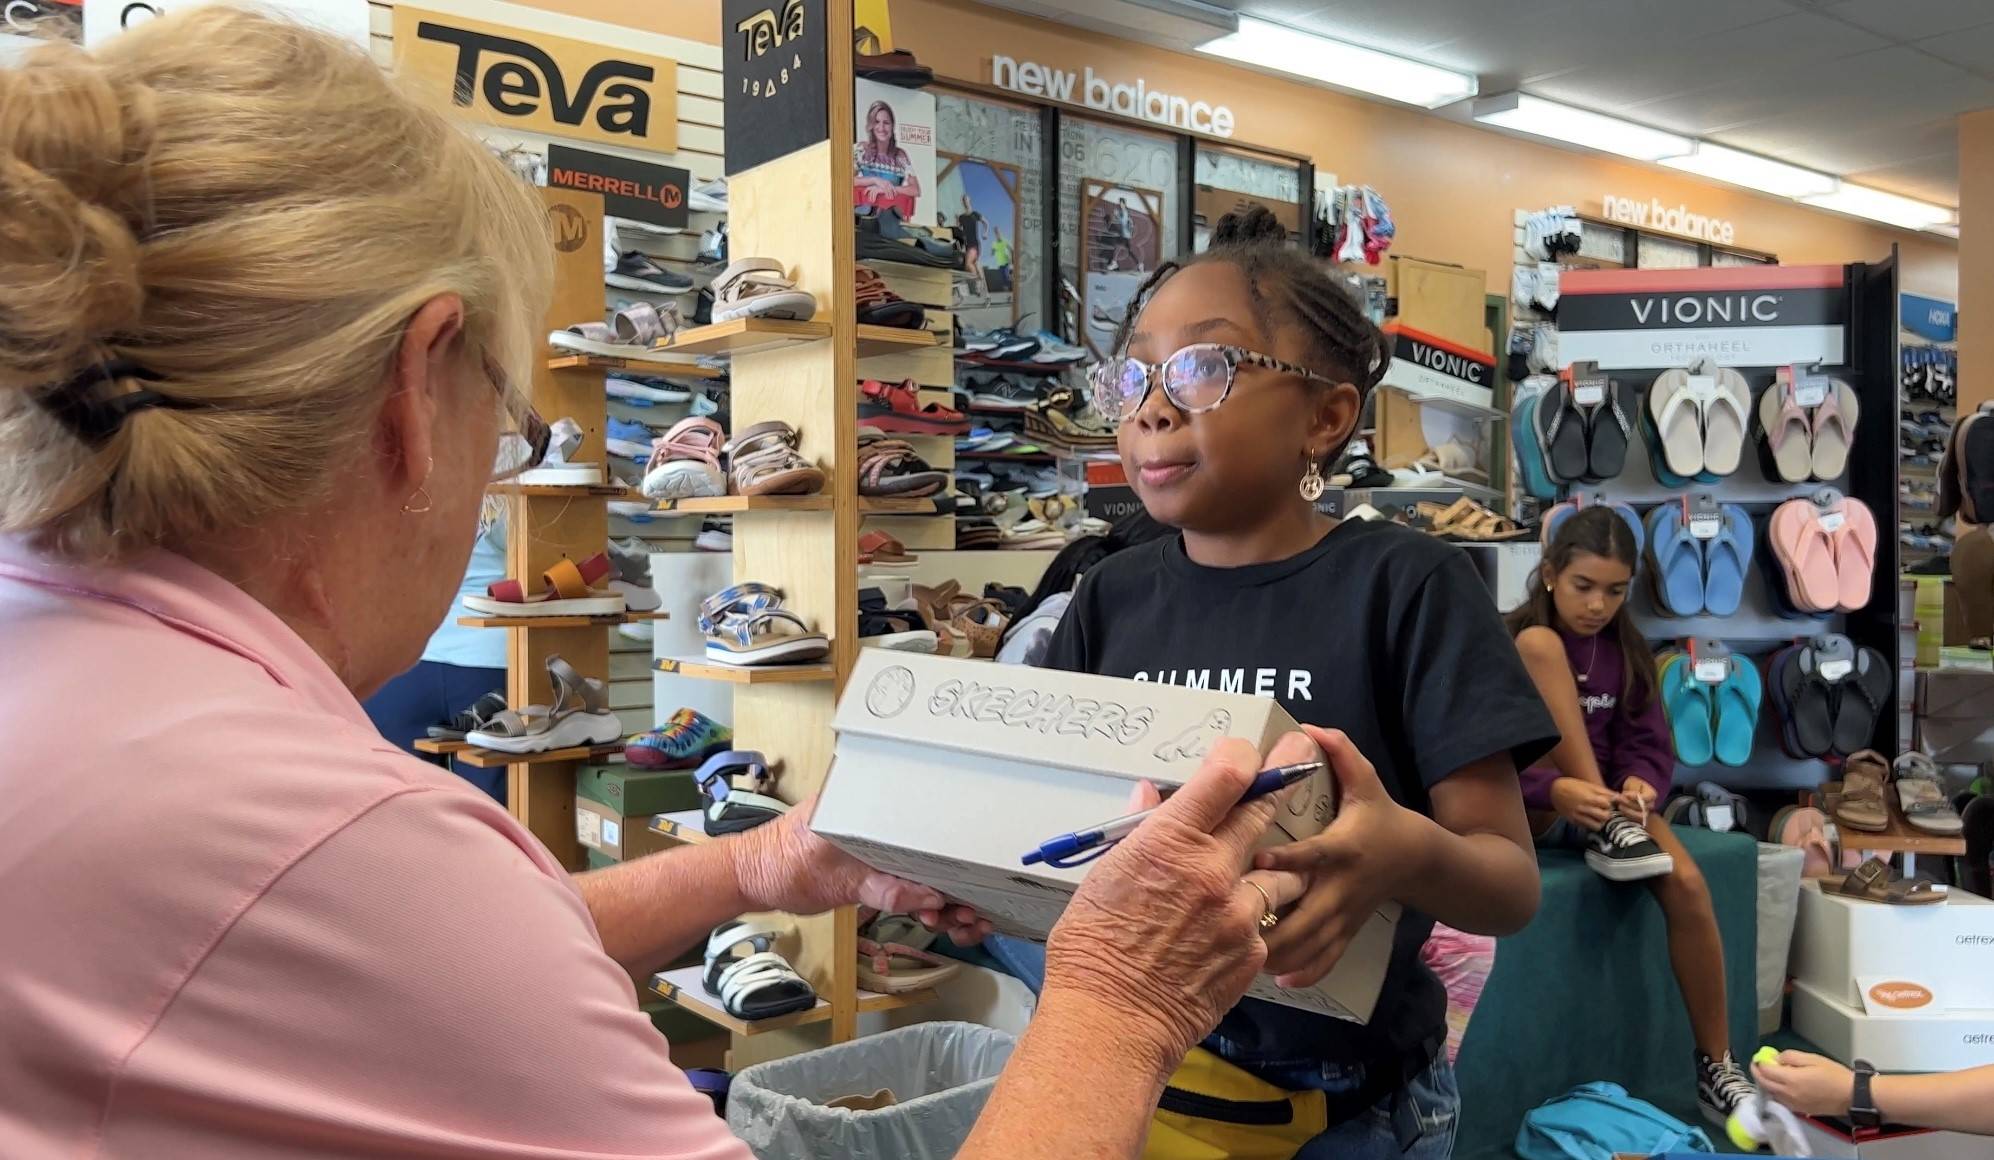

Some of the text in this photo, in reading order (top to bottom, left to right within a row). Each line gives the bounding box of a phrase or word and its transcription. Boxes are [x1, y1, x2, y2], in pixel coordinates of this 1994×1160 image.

[992, 55, 1236, 139] new balance
[553, 168, 659, 202] MERRELL
[1602, 194, 1735, 245] new balance
[1630, 294, 1783, 324] VIONIC
[1412, 341, 1482, 383] VIONIC
[1650, 340, 1753, 354] ORTHAHEEL
[1104, 502, 1141, 517] VIONI
[928, 678, 1155, 746] SKECHERS
